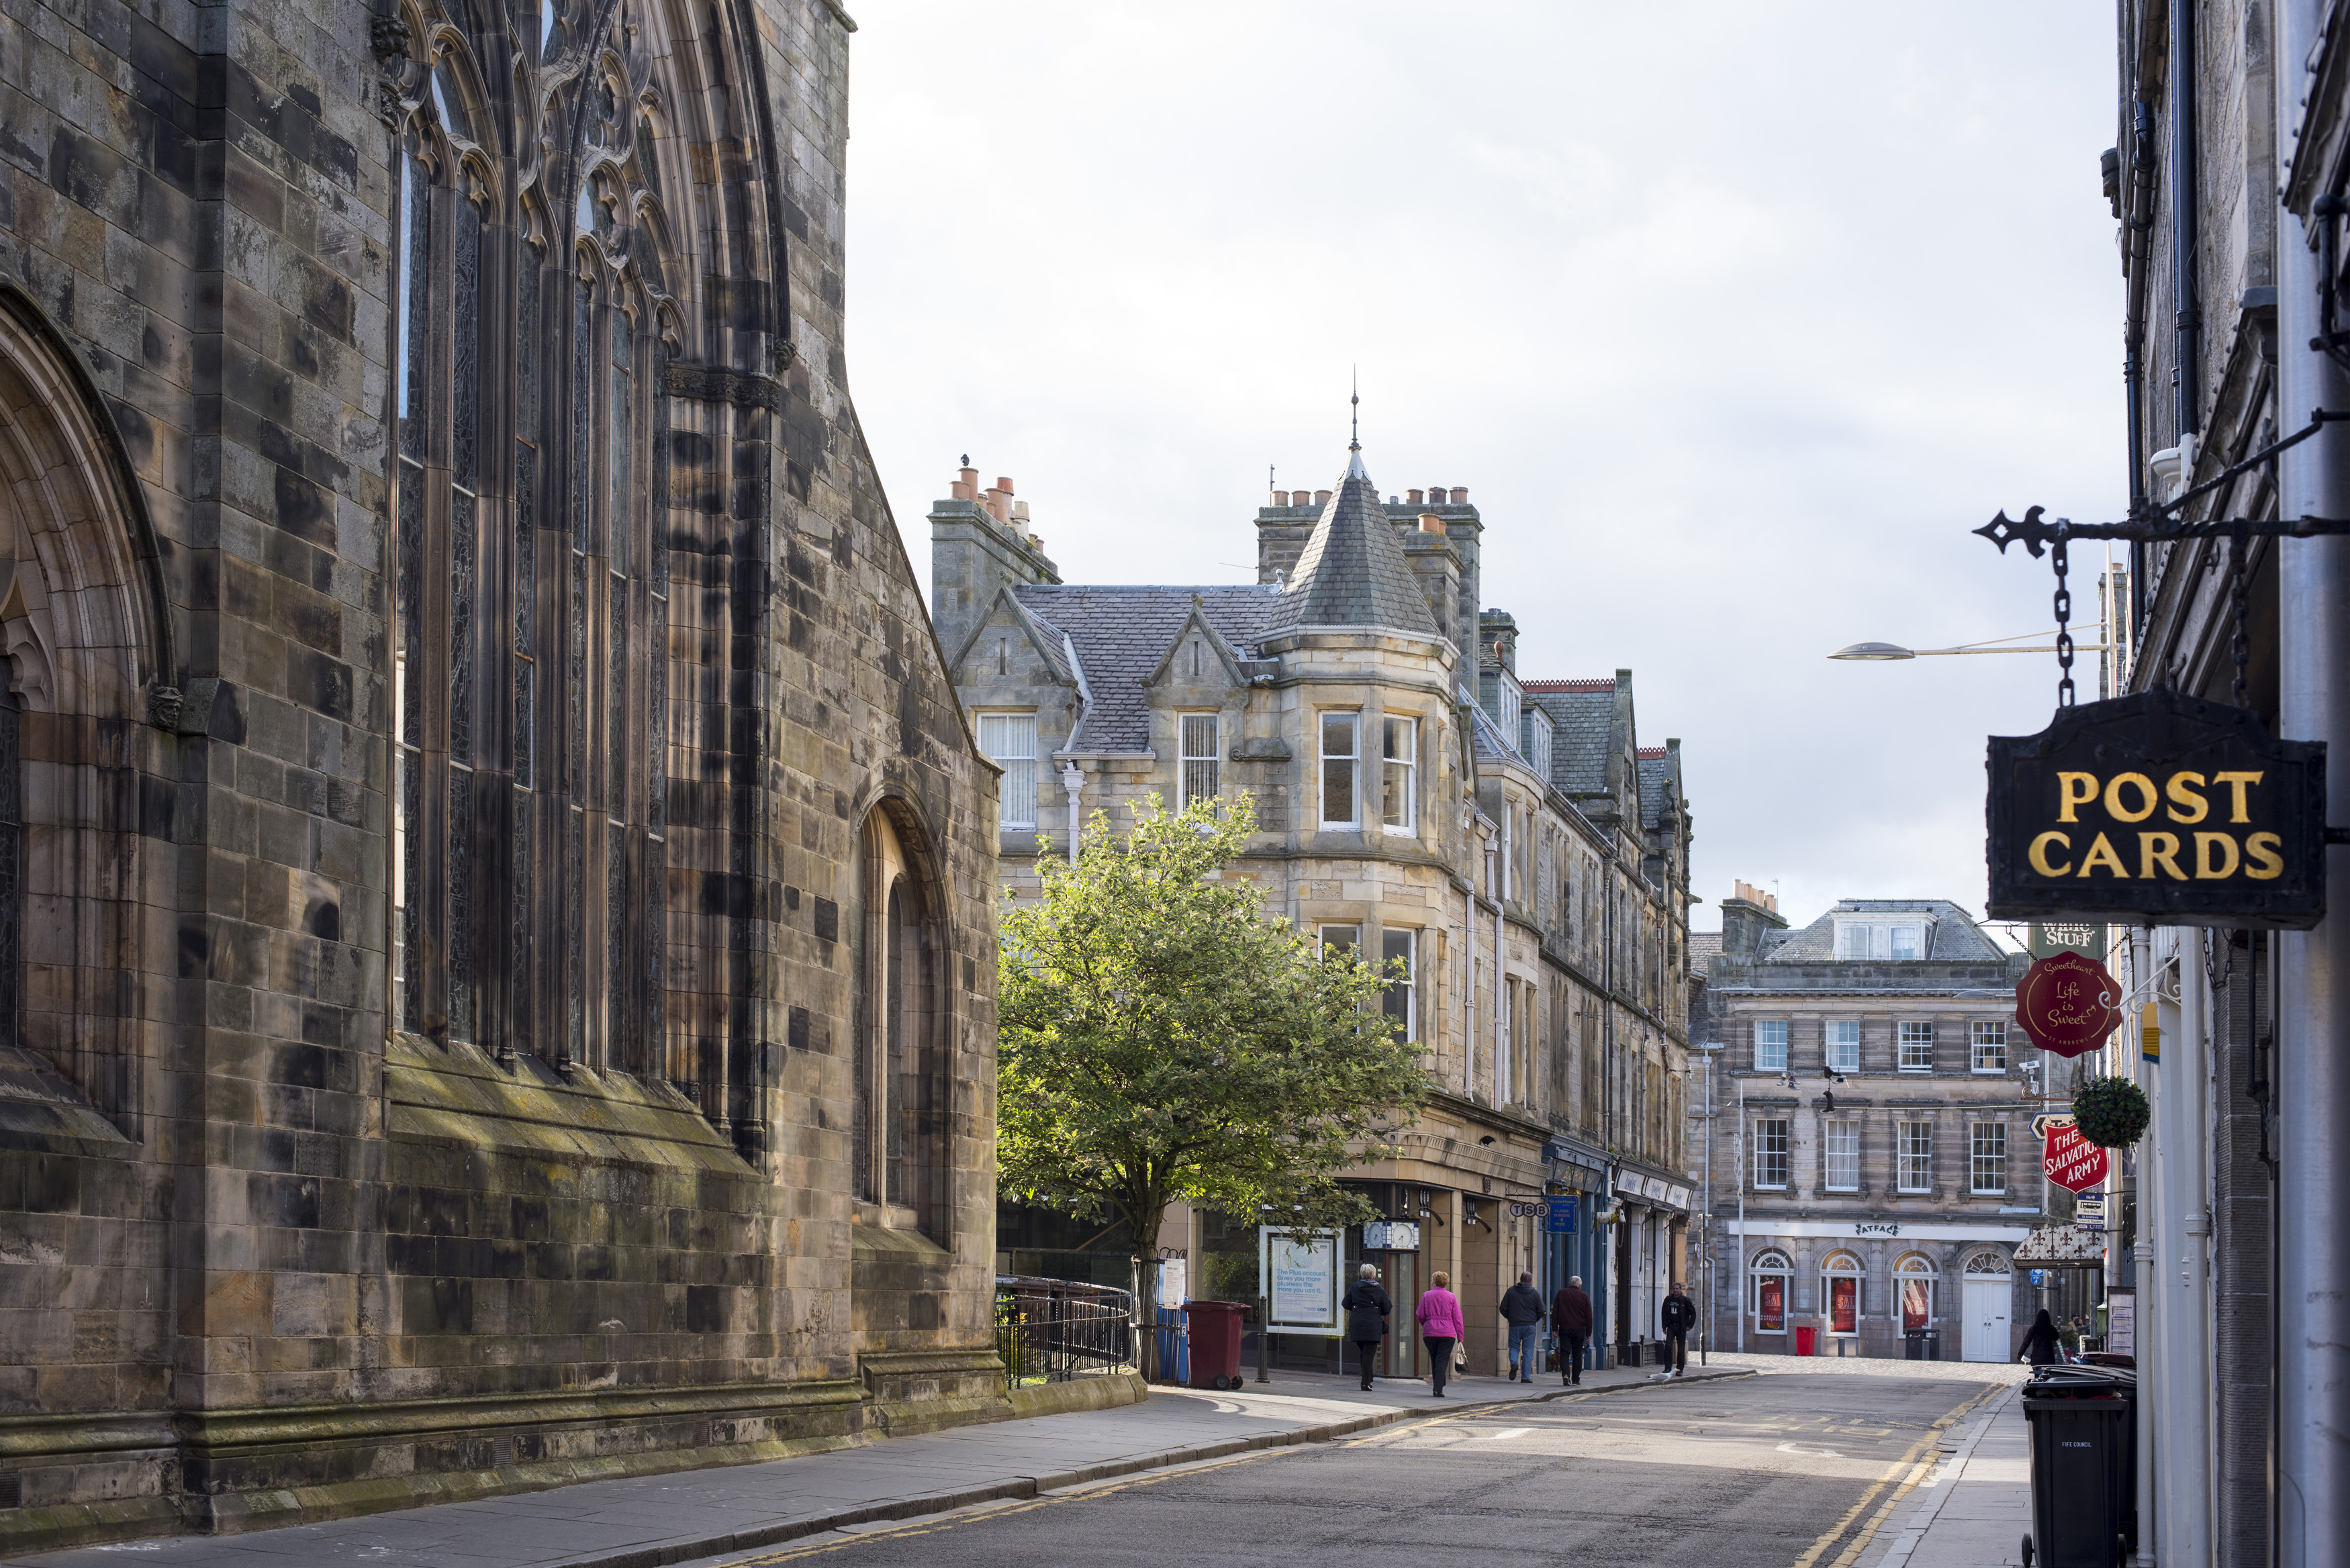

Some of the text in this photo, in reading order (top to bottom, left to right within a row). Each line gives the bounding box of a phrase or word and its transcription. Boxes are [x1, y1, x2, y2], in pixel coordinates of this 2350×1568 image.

[2055, 770, 2265, 824] POST
[2028, 830, 2284, 881] CARDS
[2044, 959, 2096, 976] Sweetheart
[2056, 981, 2081, 1001] Life
[2063, 1001, 2074, 1011] is
[2048, 1009, 2088, 1027] Sweet
[2058, 1036, 2089, 1045] ANDREWS
[2054, 1128, 2079, 1152] THE
[2045, 1139, 2101, 1175] SALVATIO
[2066, 1153, 2100, 1185] ARMY
[1513, 1205, 1546, 1215] TSB
[1765, 1293, 1781, 1306] SAL
[1837, 1295, 1856, 1308] SAL
[1182, 1327, 1186, 1336] 2
